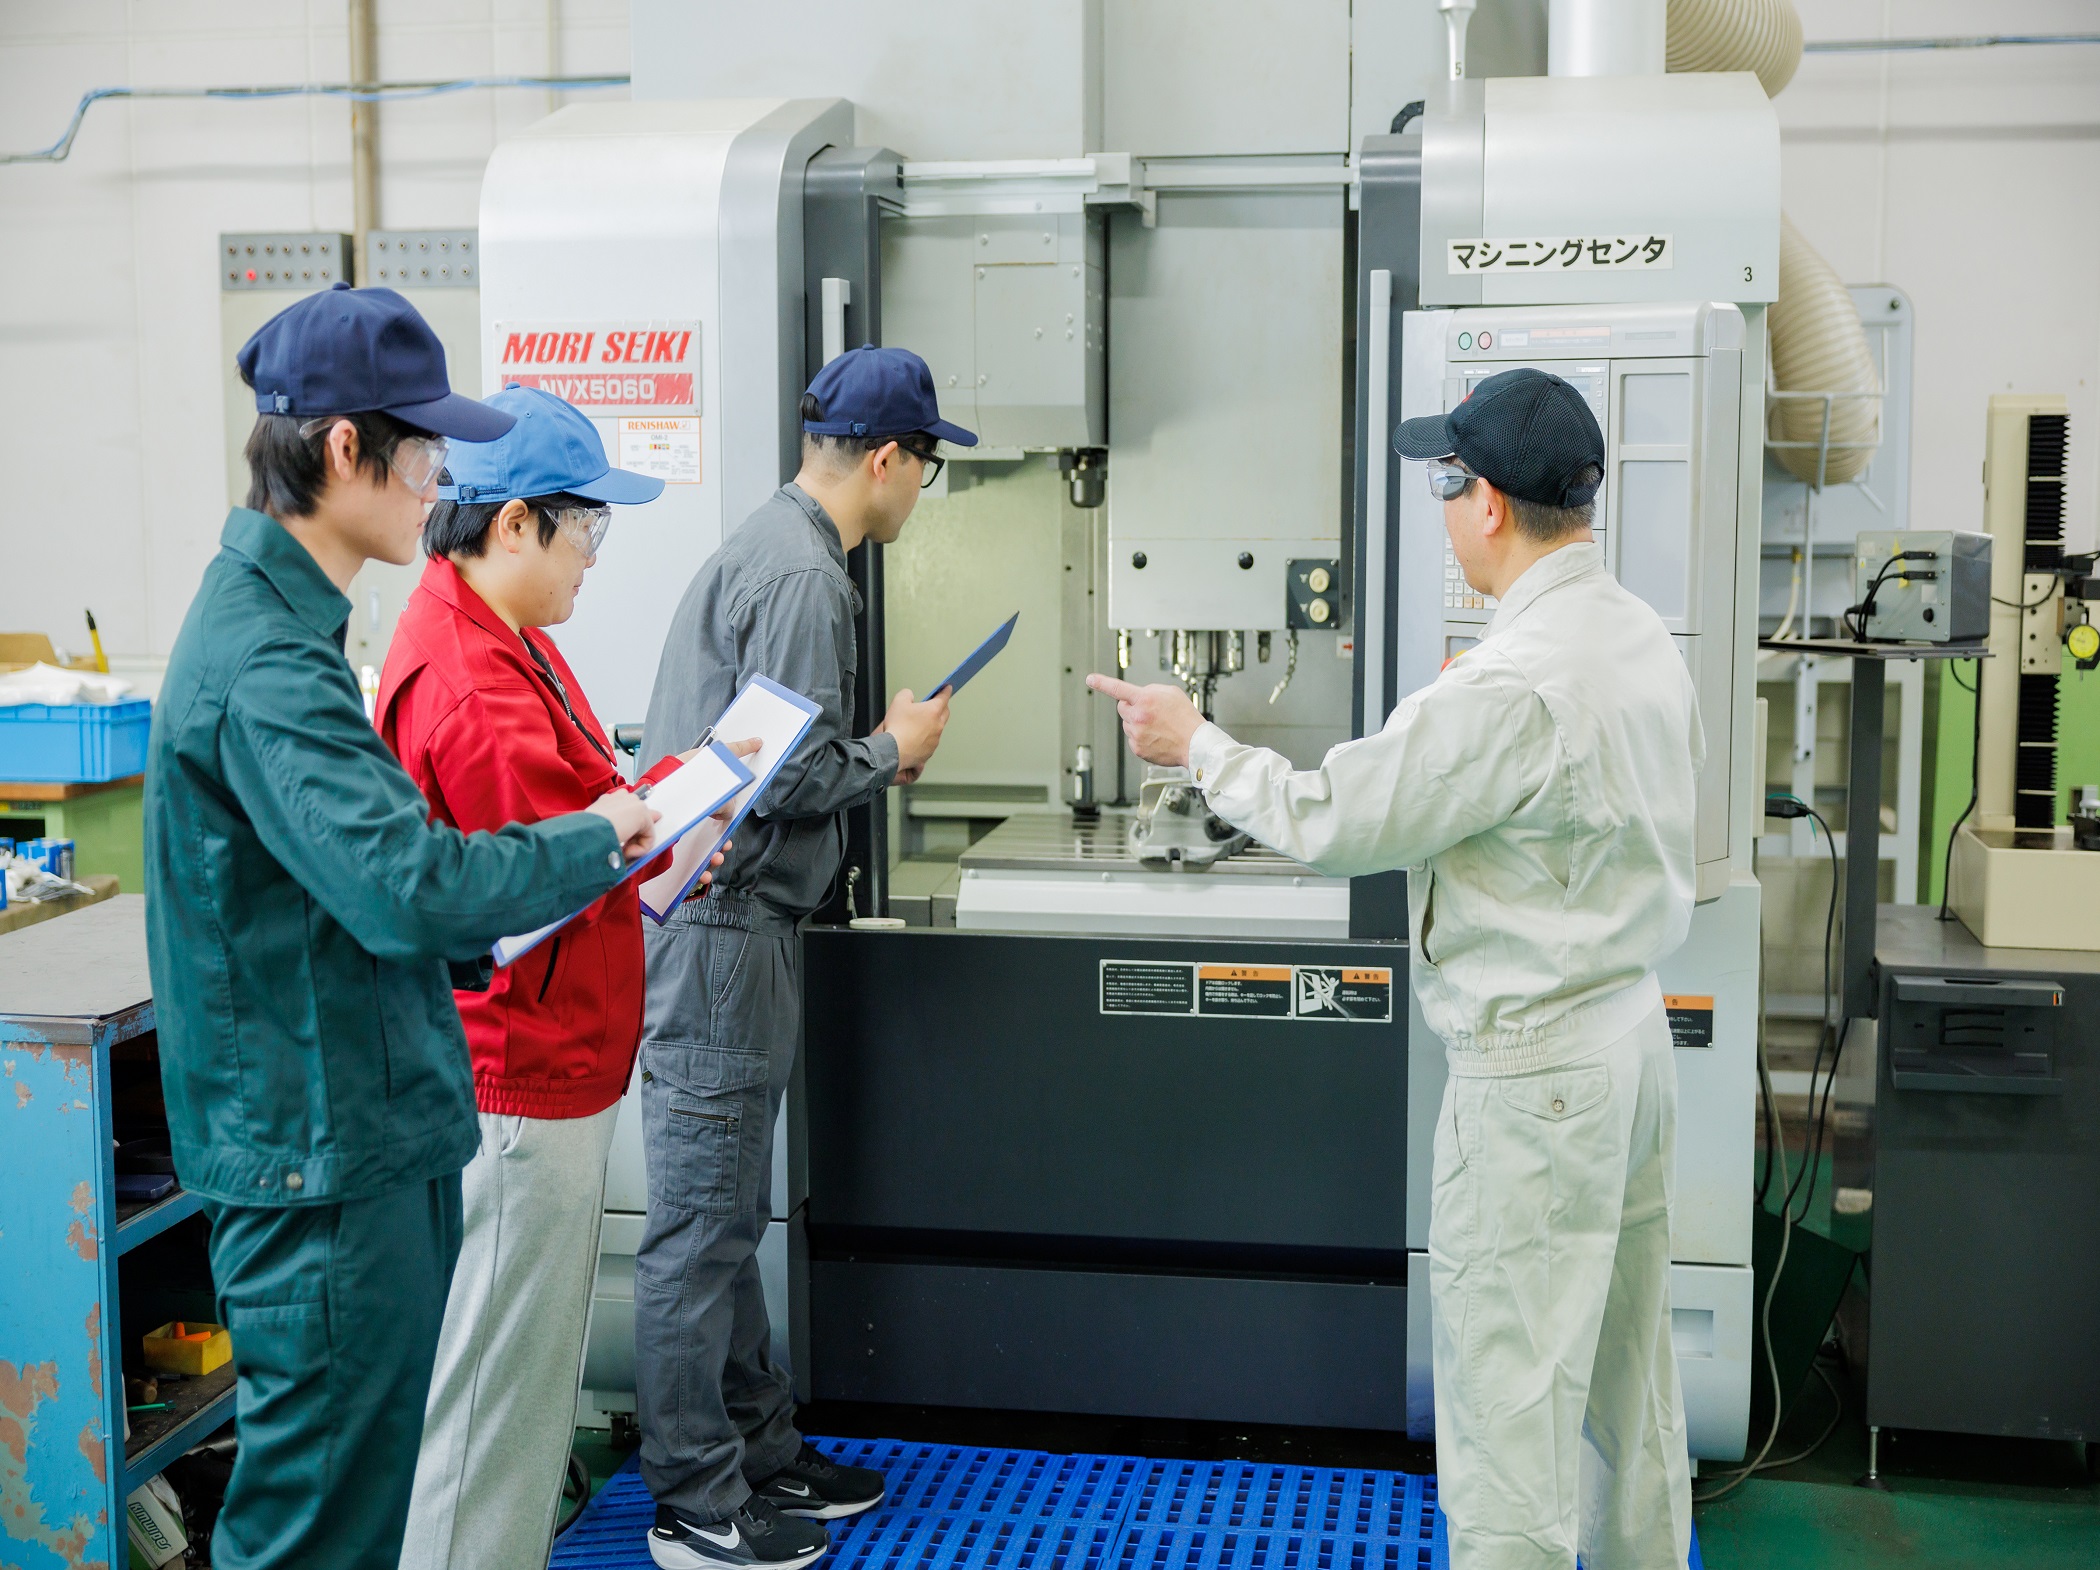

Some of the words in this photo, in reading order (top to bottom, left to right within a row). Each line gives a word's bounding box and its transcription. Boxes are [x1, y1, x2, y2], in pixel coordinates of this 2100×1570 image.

[1455, 61, 1462, 75] 5
[1453, 236, 1666, 269] マシニングセンタ
[1744, 266, 1753, 283] 3
[502, 332, 595, 363] MORI
[602, 331, 691, 363] SEIKI
[540, 379, 655, 400] NVX5060
[627, 421, 679, 430] RENISHAW
